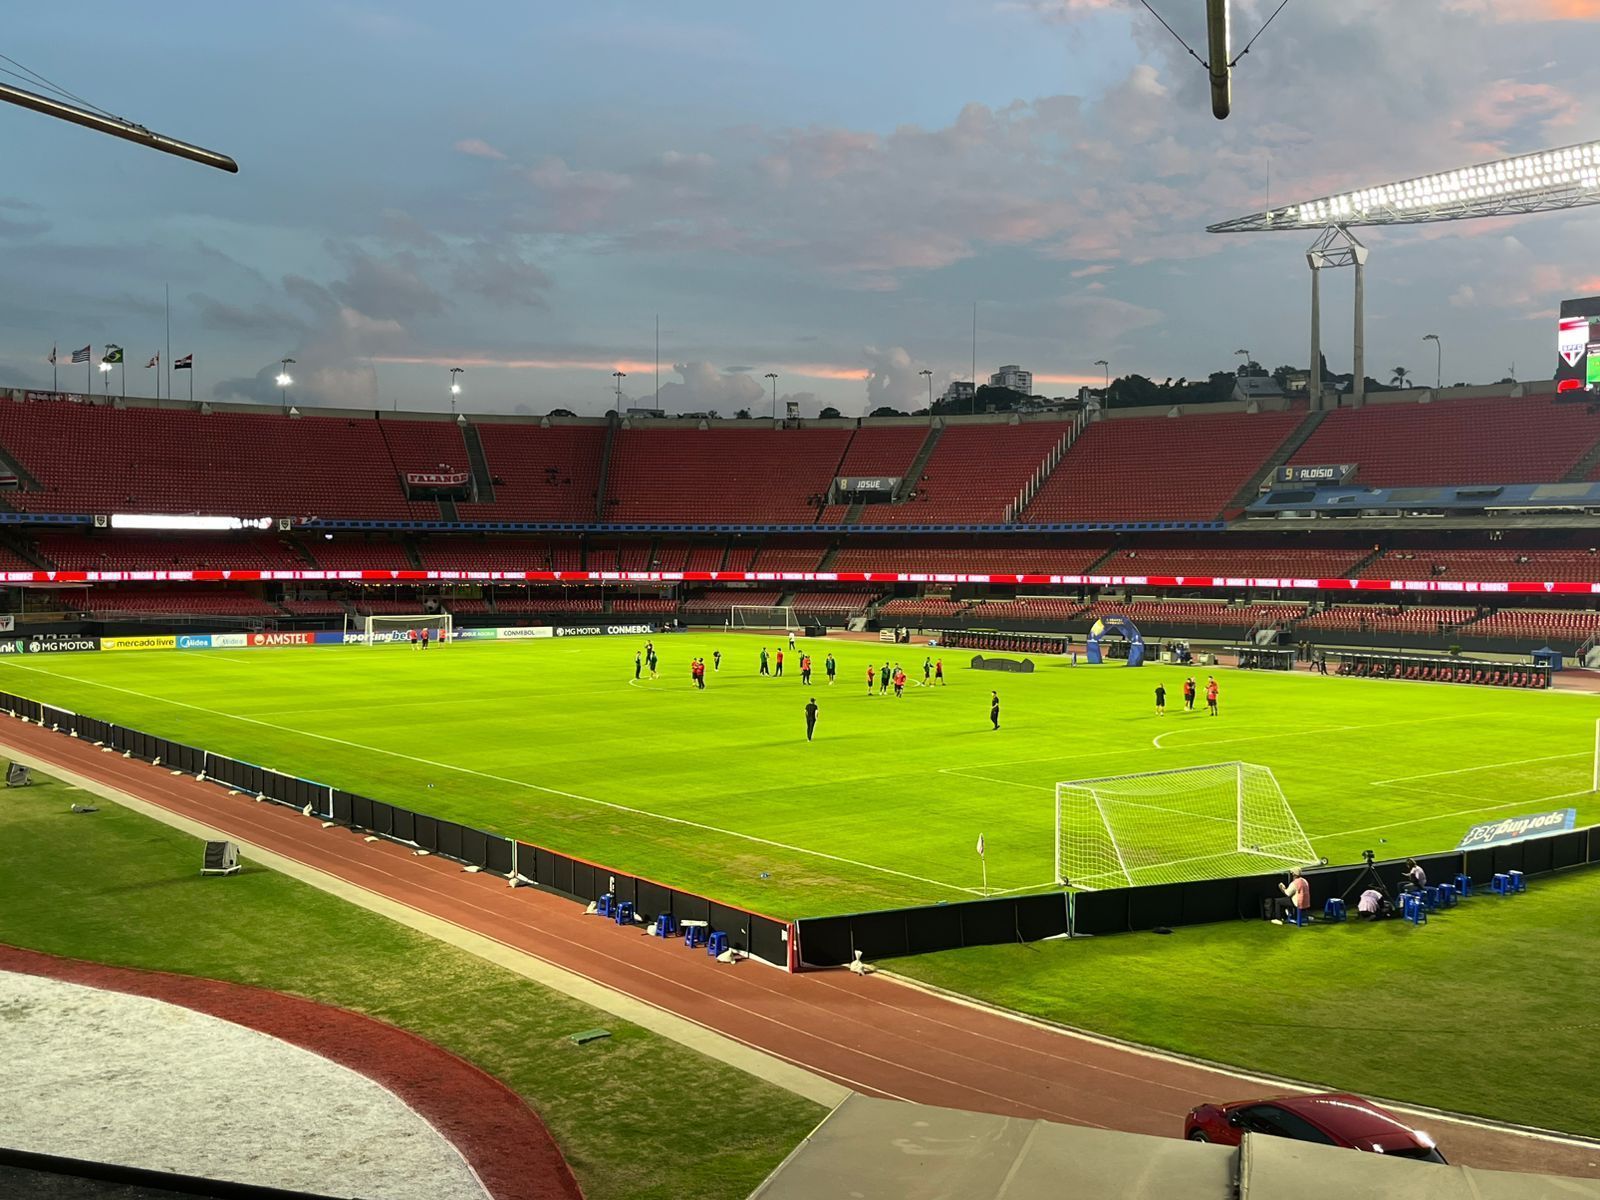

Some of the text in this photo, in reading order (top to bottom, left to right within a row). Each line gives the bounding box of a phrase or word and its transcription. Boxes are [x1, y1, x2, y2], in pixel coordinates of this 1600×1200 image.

[1285, 468, 1293, 480] 9
[840, 479, 848, 489] 8
[577, 627, 601, 635] MOTOR
[607, 625, 653, 634] CONMEBOL
[116, 638, 175, 648] mercado livre
[187, 638, 208, 647] Midea
[266, 634, 308, 645] AMSTEL
[0, 642, 15, 653] nk
[42, 640, 95, 651] MG MOTOR
[1461, 811, 1564, 846] sportingbet
